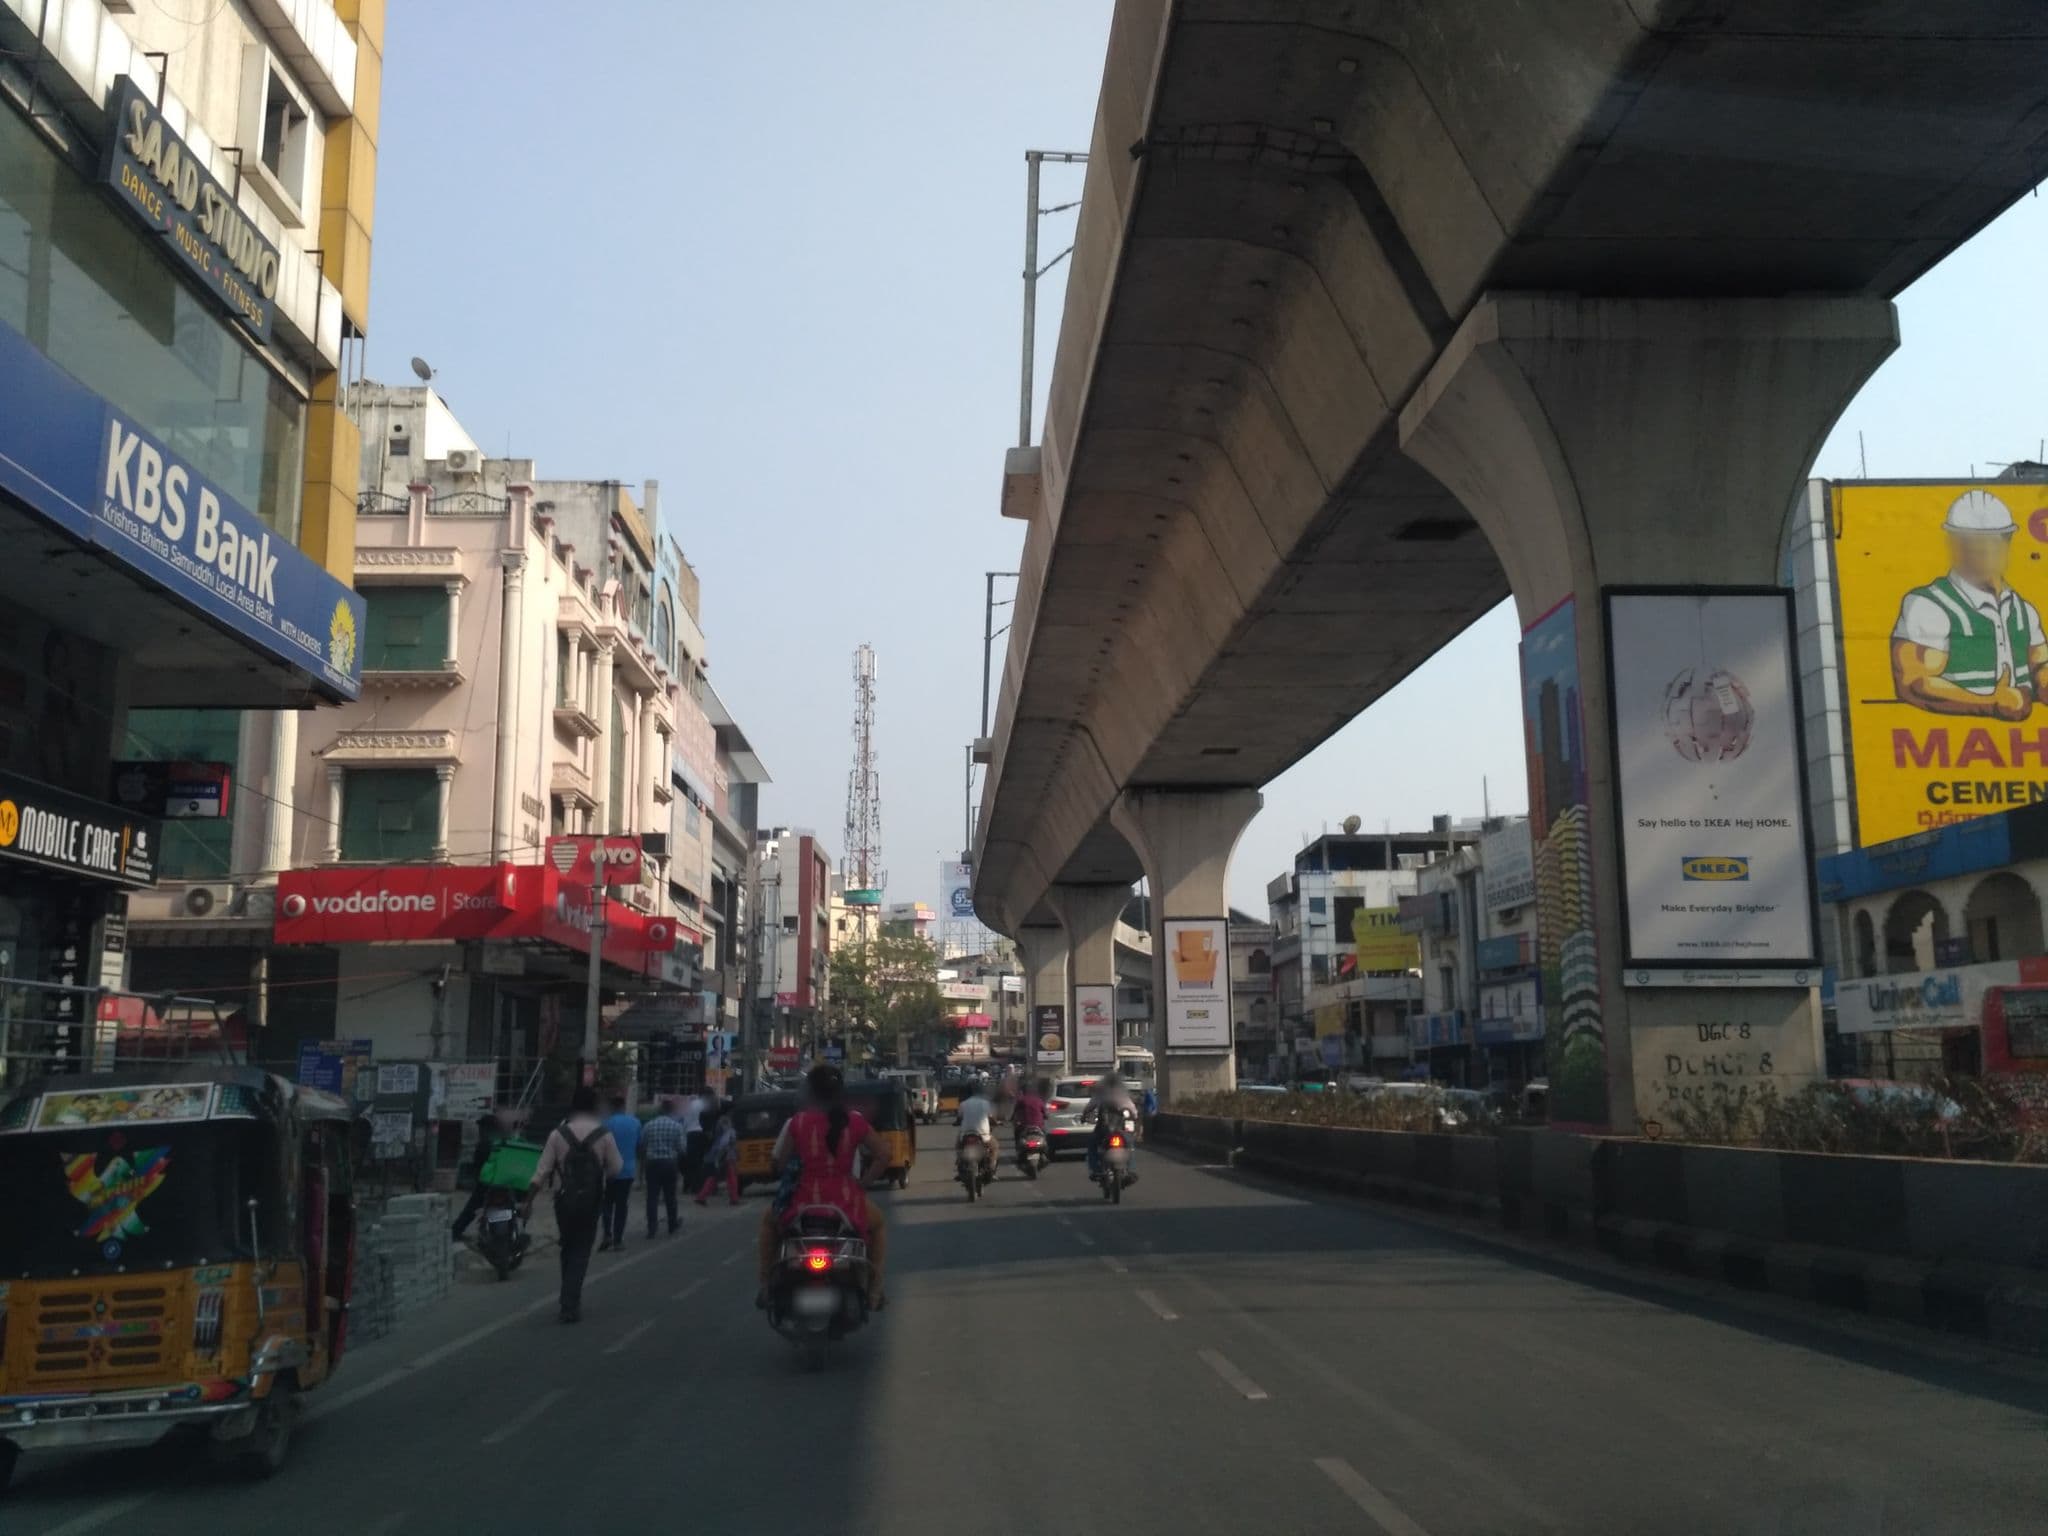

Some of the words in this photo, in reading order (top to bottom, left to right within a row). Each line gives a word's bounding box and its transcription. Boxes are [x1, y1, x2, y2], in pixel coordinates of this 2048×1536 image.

[124, 99, 198, 211] SAAD
[197, 182, 278, 299] STUDIO
[122, 164, 164, 221] DANCE
[175, 223, 211, 271] MUSIC
[223, 272, 263, 327] FITNESS
[106, 419, 189, 541] KBS
[195, 486, 279, 606] Bank
[103, 501, 139, 538] Krishna
[141, 525, 169, 557] Bhima
[170, 546, 215, 586] Samruddhi
[216, 576, 236, 600] Local
[237, 589, 255, 612] Area
[255, 603, 273, 625] Bank
[280, 618, 297, 638] WITH
[1892, 728, 2048, 769] MAH
[1926, 781, 2048, 805] CEMEN
[19, 805, 79, 863] MOBILE
[82, 823, 120, 872] CARE
[1638, 818, 1657, 829] Say
[1660, 818, 1687, 828] hello
[1689, 819, 1701, 828] to
[1704, 818, 1731, 828] IKEA
[1735, 818, 1753, 830] Hej
[1756, 818, 1792, 828] HOME.
[1691, 863, 1741, 873] IKEA
[312, 890, 436, 914] vodafone
[453, 890, 497, 911] Store
[1660, 904, 1687, 913] Make
[1689, 904, 1733, 914] Everyday
[1735, 904, 1776, 914] Brighter
